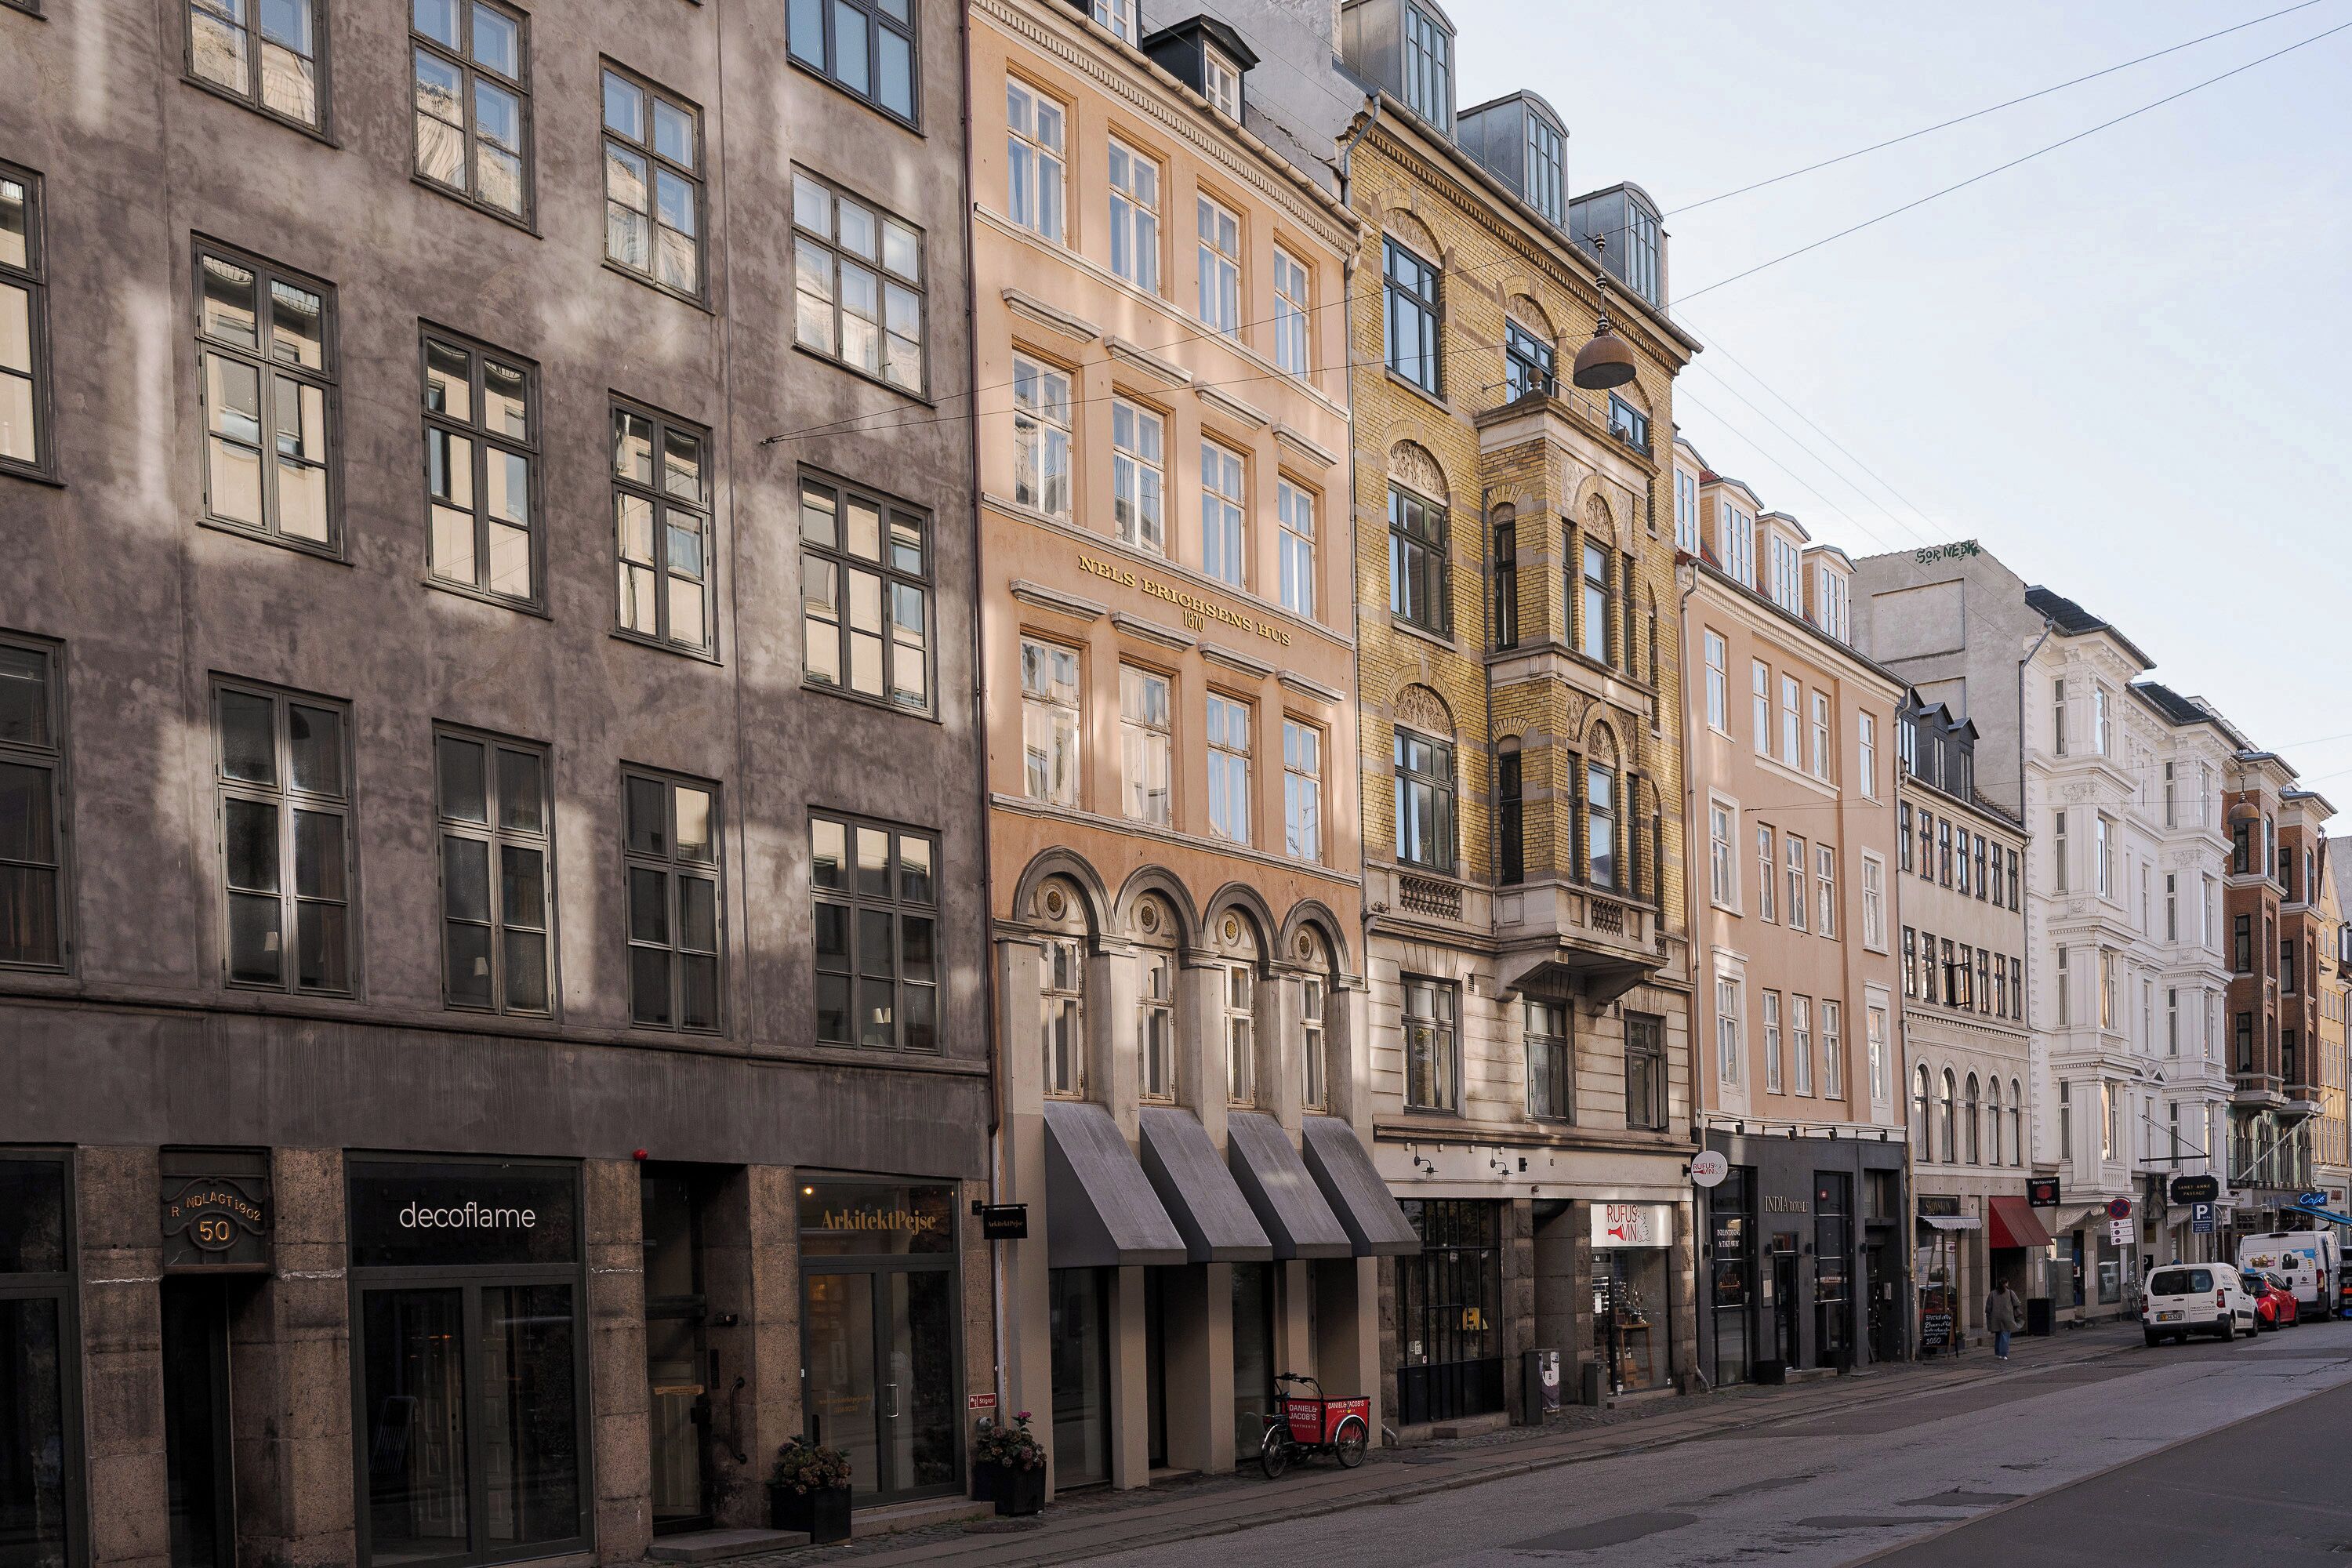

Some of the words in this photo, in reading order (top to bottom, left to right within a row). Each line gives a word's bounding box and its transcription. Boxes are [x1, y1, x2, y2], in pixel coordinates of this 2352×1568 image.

[1079, 554, 1136, 588] NELS
[1142, 578, 1253, 632] ERICHSENS
[1256, 621, 1291, 646] HUS
[1183, 609, 1205, 632] 1870
[1765, 1196, 1788, 1212] INDIA
[2299, 1192, 2326, 1204] Café
[399, 1201, 536, 1228] decoflame
[1607, 1205, 1637, 1223] RUFUS
[2196, 1204, 2208, 1220] P
[199, 1221, 230, 1243] 50
[822, 1209, 937, 1236] ArkitektPejse
[1621, 1223, 1637, 1241] VIN
